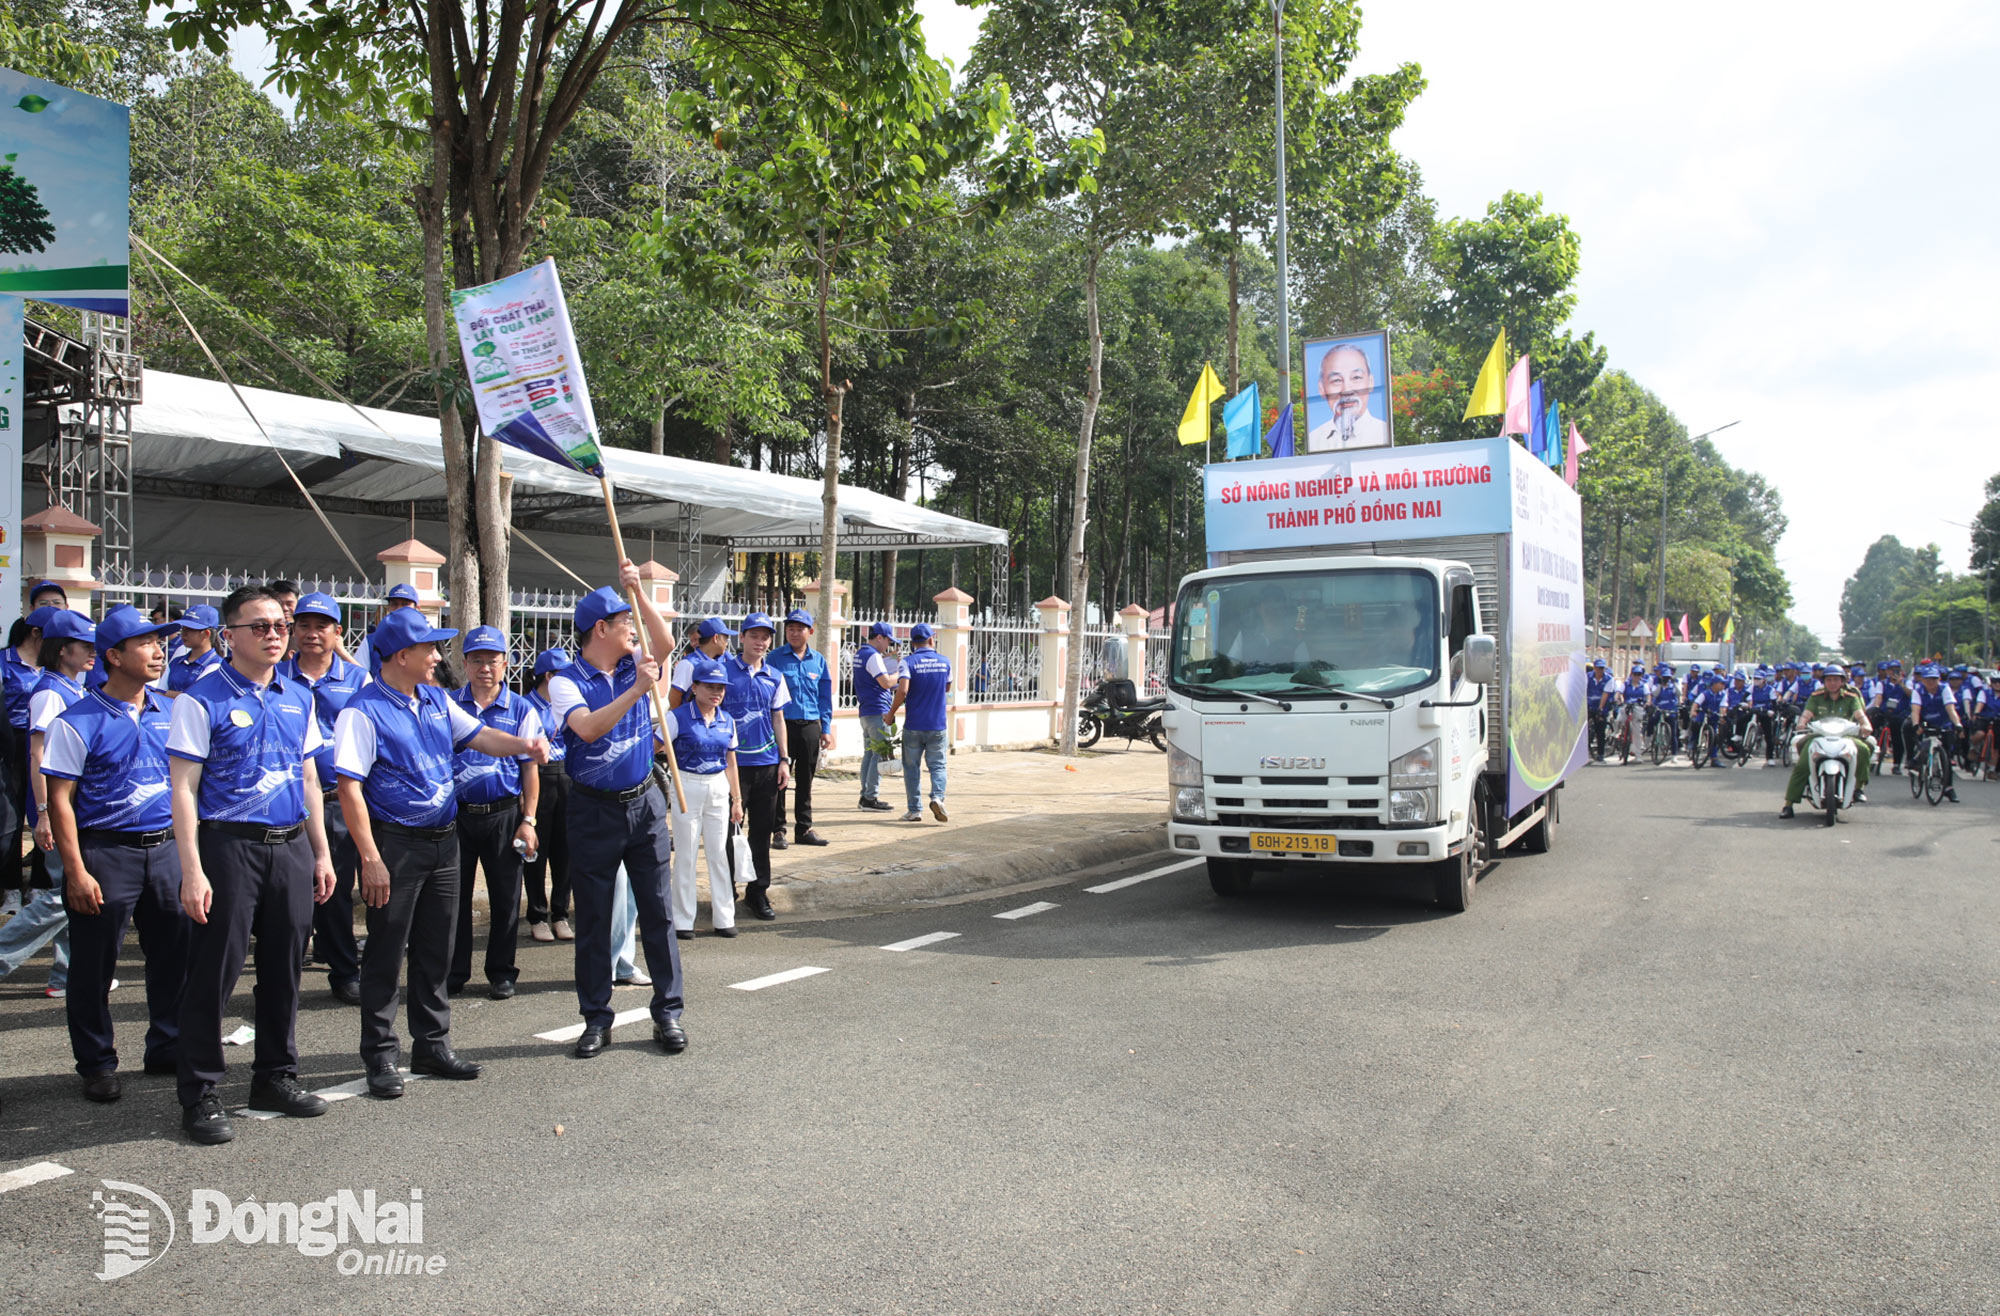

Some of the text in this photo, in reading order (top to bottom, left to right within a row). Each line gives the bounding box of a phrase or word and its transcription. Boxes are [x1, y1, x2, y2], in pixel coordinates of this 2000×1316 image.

[1221, 463, 1492, 504] SỞ NÔNG NGHIỆP VÀ MÔI TRƯỜNG
[1267, 498, 1442, 529] THÀNH PHỐ ĐỒNG NAI
[1350, 718, 1385, 726] NMR
[1259, 756, 1327, 769] ISUZU
[1256, 834, 1329, 850] 60H-219.18
